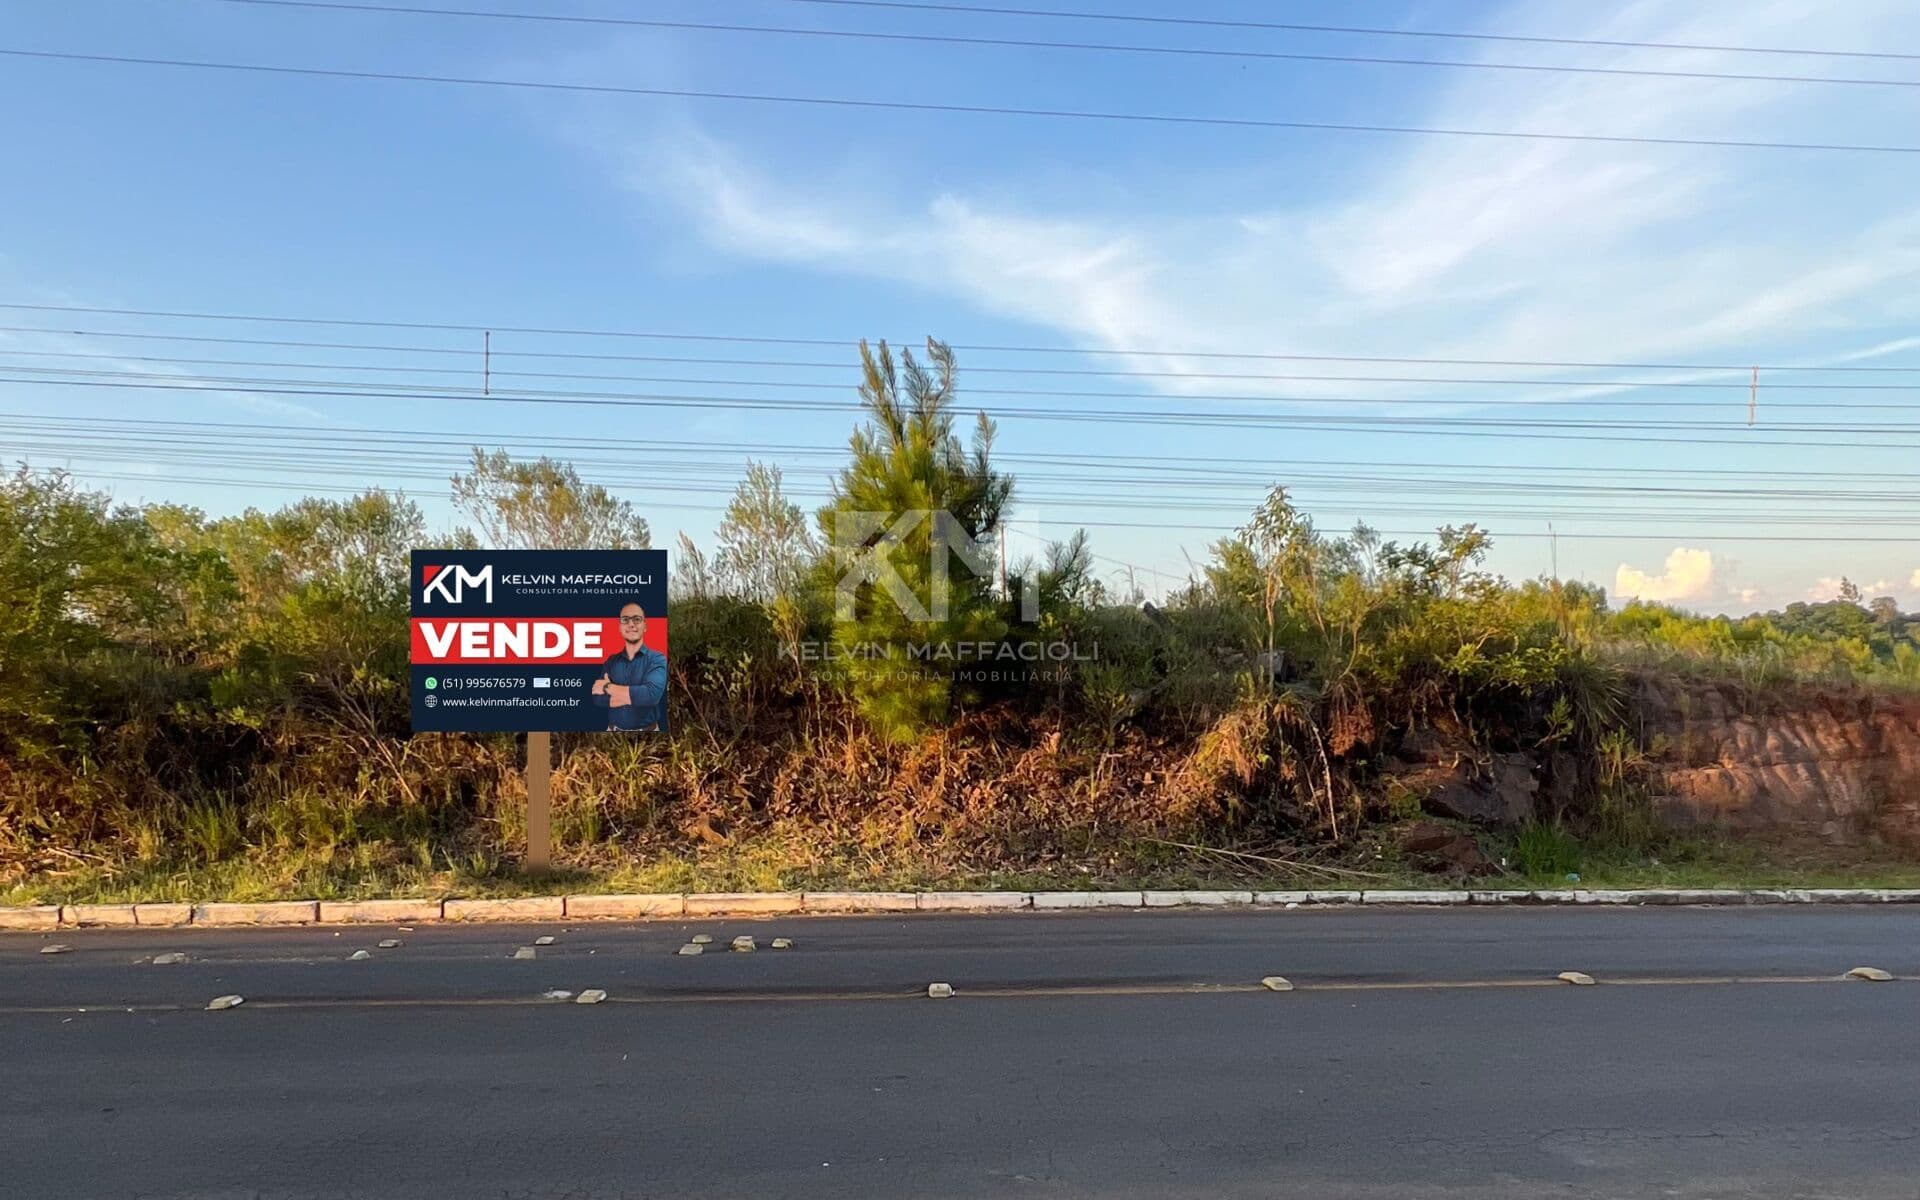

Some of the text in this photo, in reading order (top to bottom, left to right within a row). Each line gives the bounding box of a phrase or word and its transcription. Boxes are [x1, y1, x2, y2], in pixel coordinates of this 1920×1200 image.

[423, 565, 493, 603] KM
[502, 574, 652, 585] KELVIN MAFFACIOLI
[582, 587, 640, 595] IMOBILIÁRIA
[419, 622, 603, 658] VENDE
[442, 678, 583, 690] (51) 995676579 61066
[442, 697, 581, 707] www.kelvinmaffacioli.com.br
